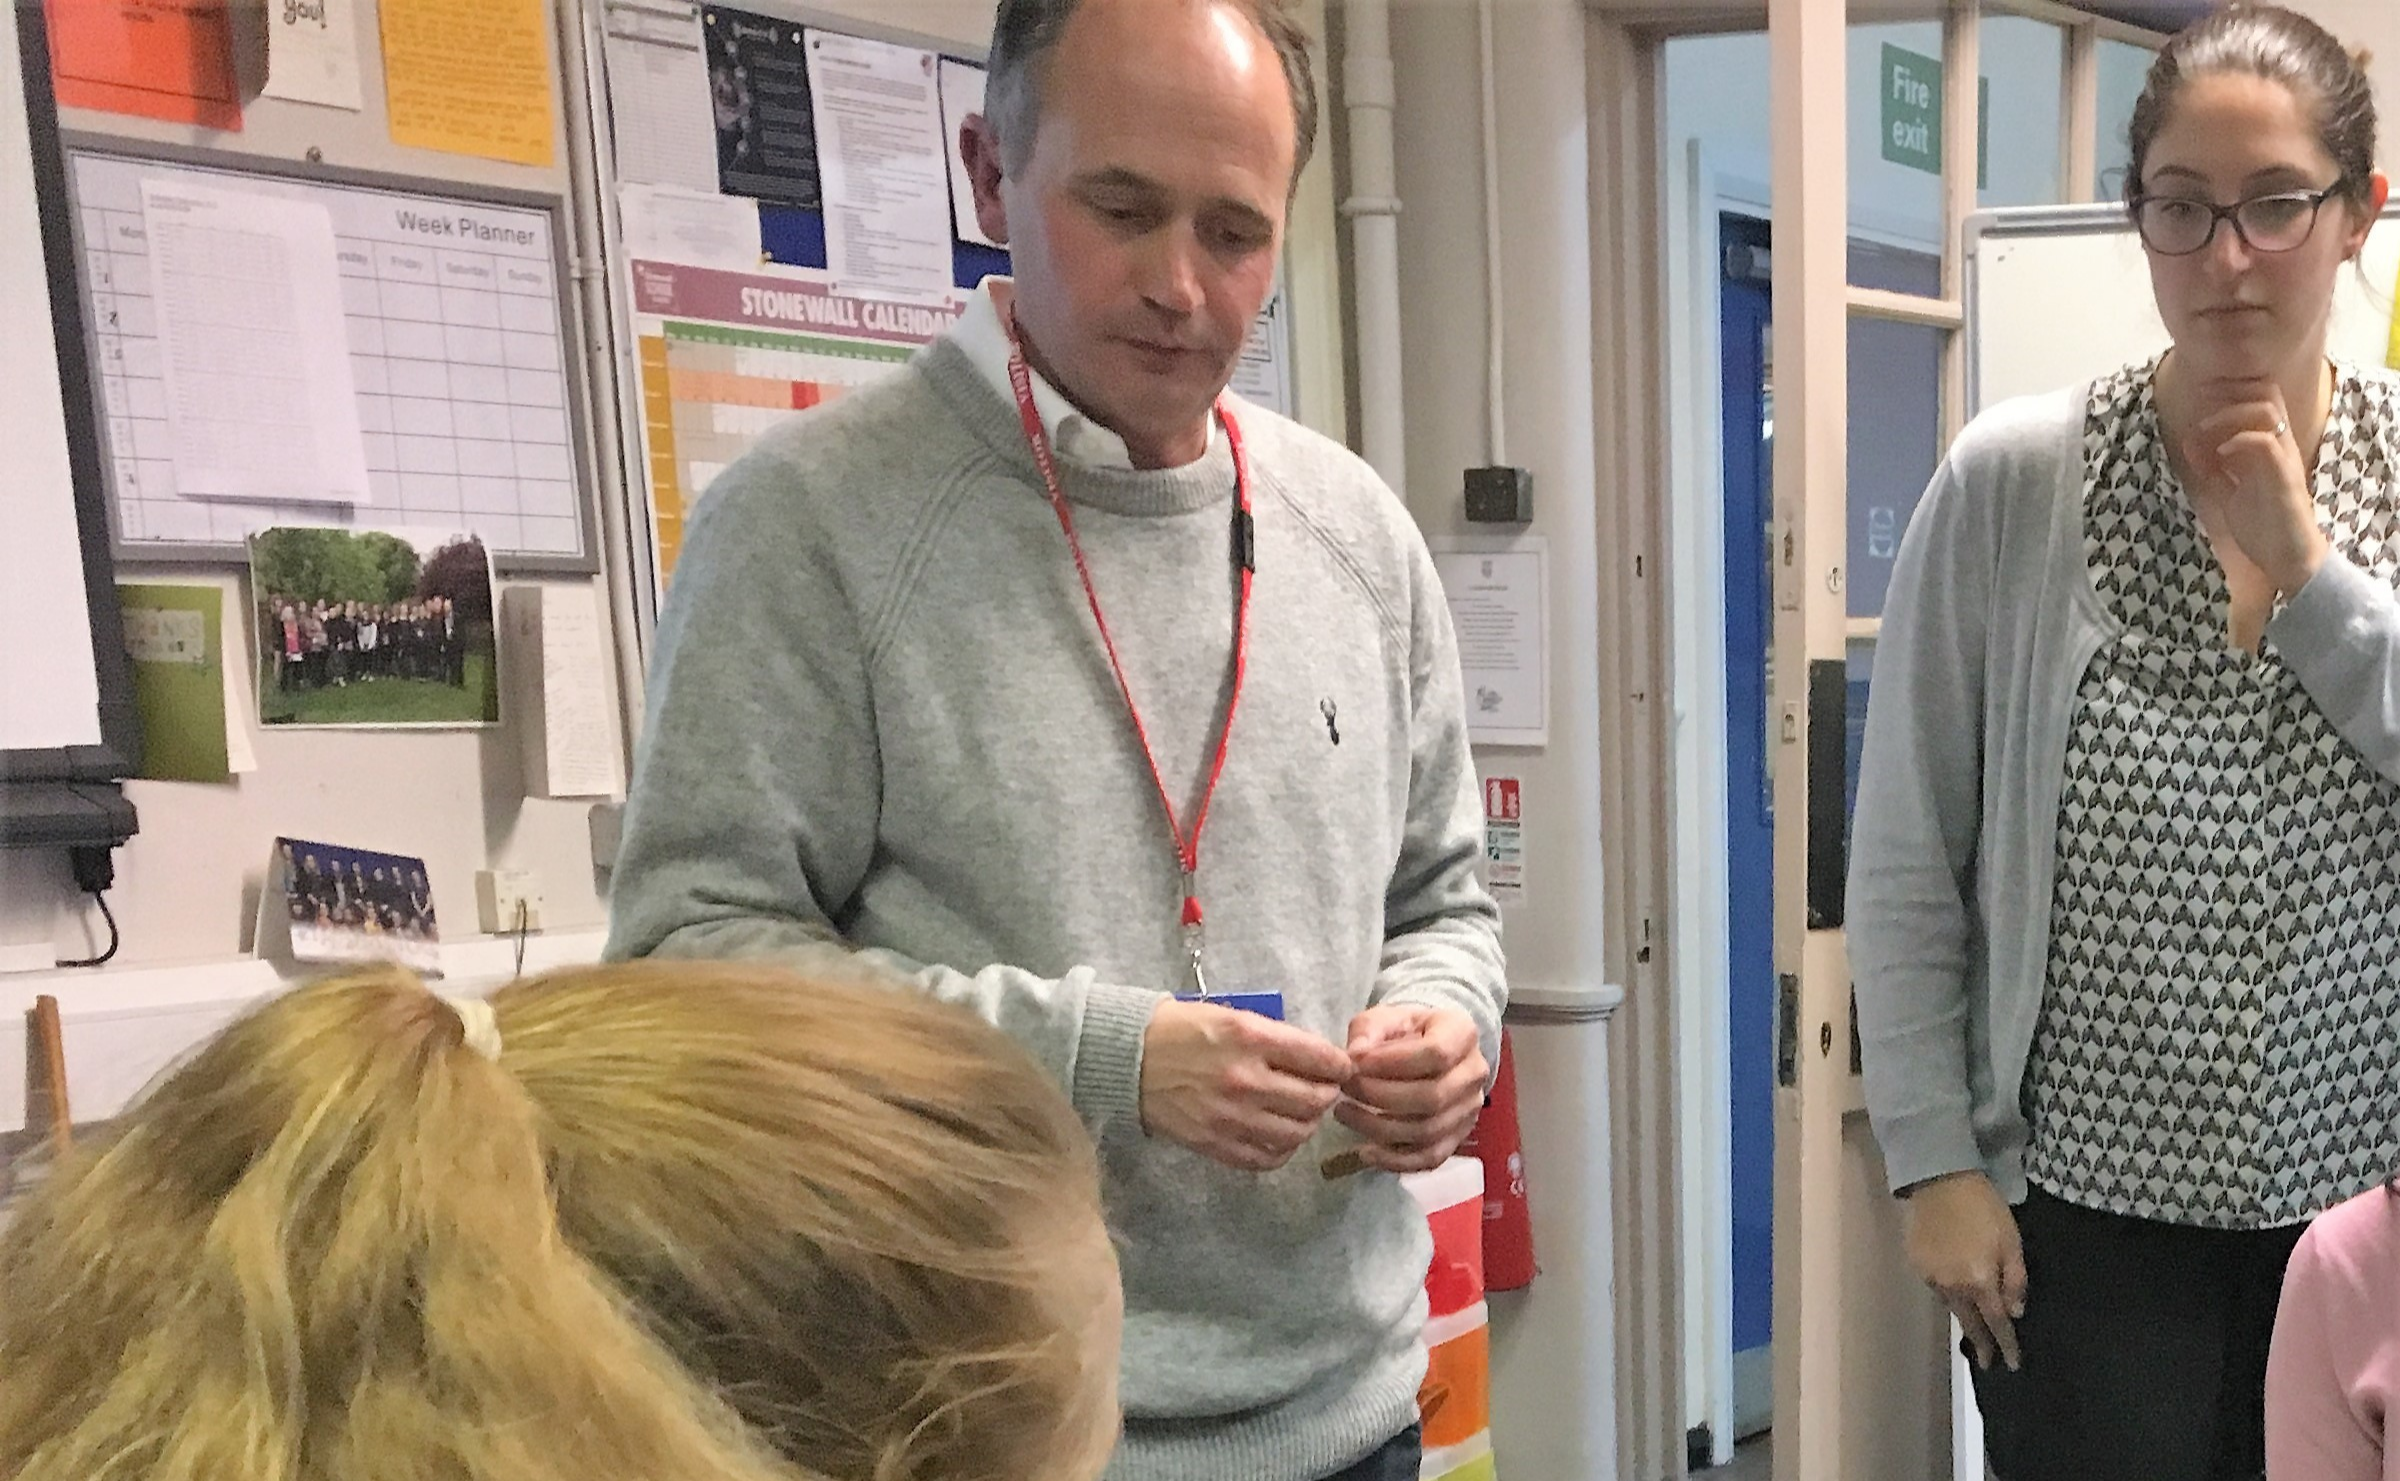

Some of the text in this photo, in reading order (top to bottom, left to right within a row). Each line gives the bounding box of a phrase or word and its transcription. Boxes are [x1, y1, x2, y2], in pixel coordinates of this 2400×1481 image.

[1893, 64, 1930, 109] Fire
[1892, 118, 1928, 154] exit
[394, 210, 536, 246] Week Planner
[741, 287, 860, 329] STONEWALL
